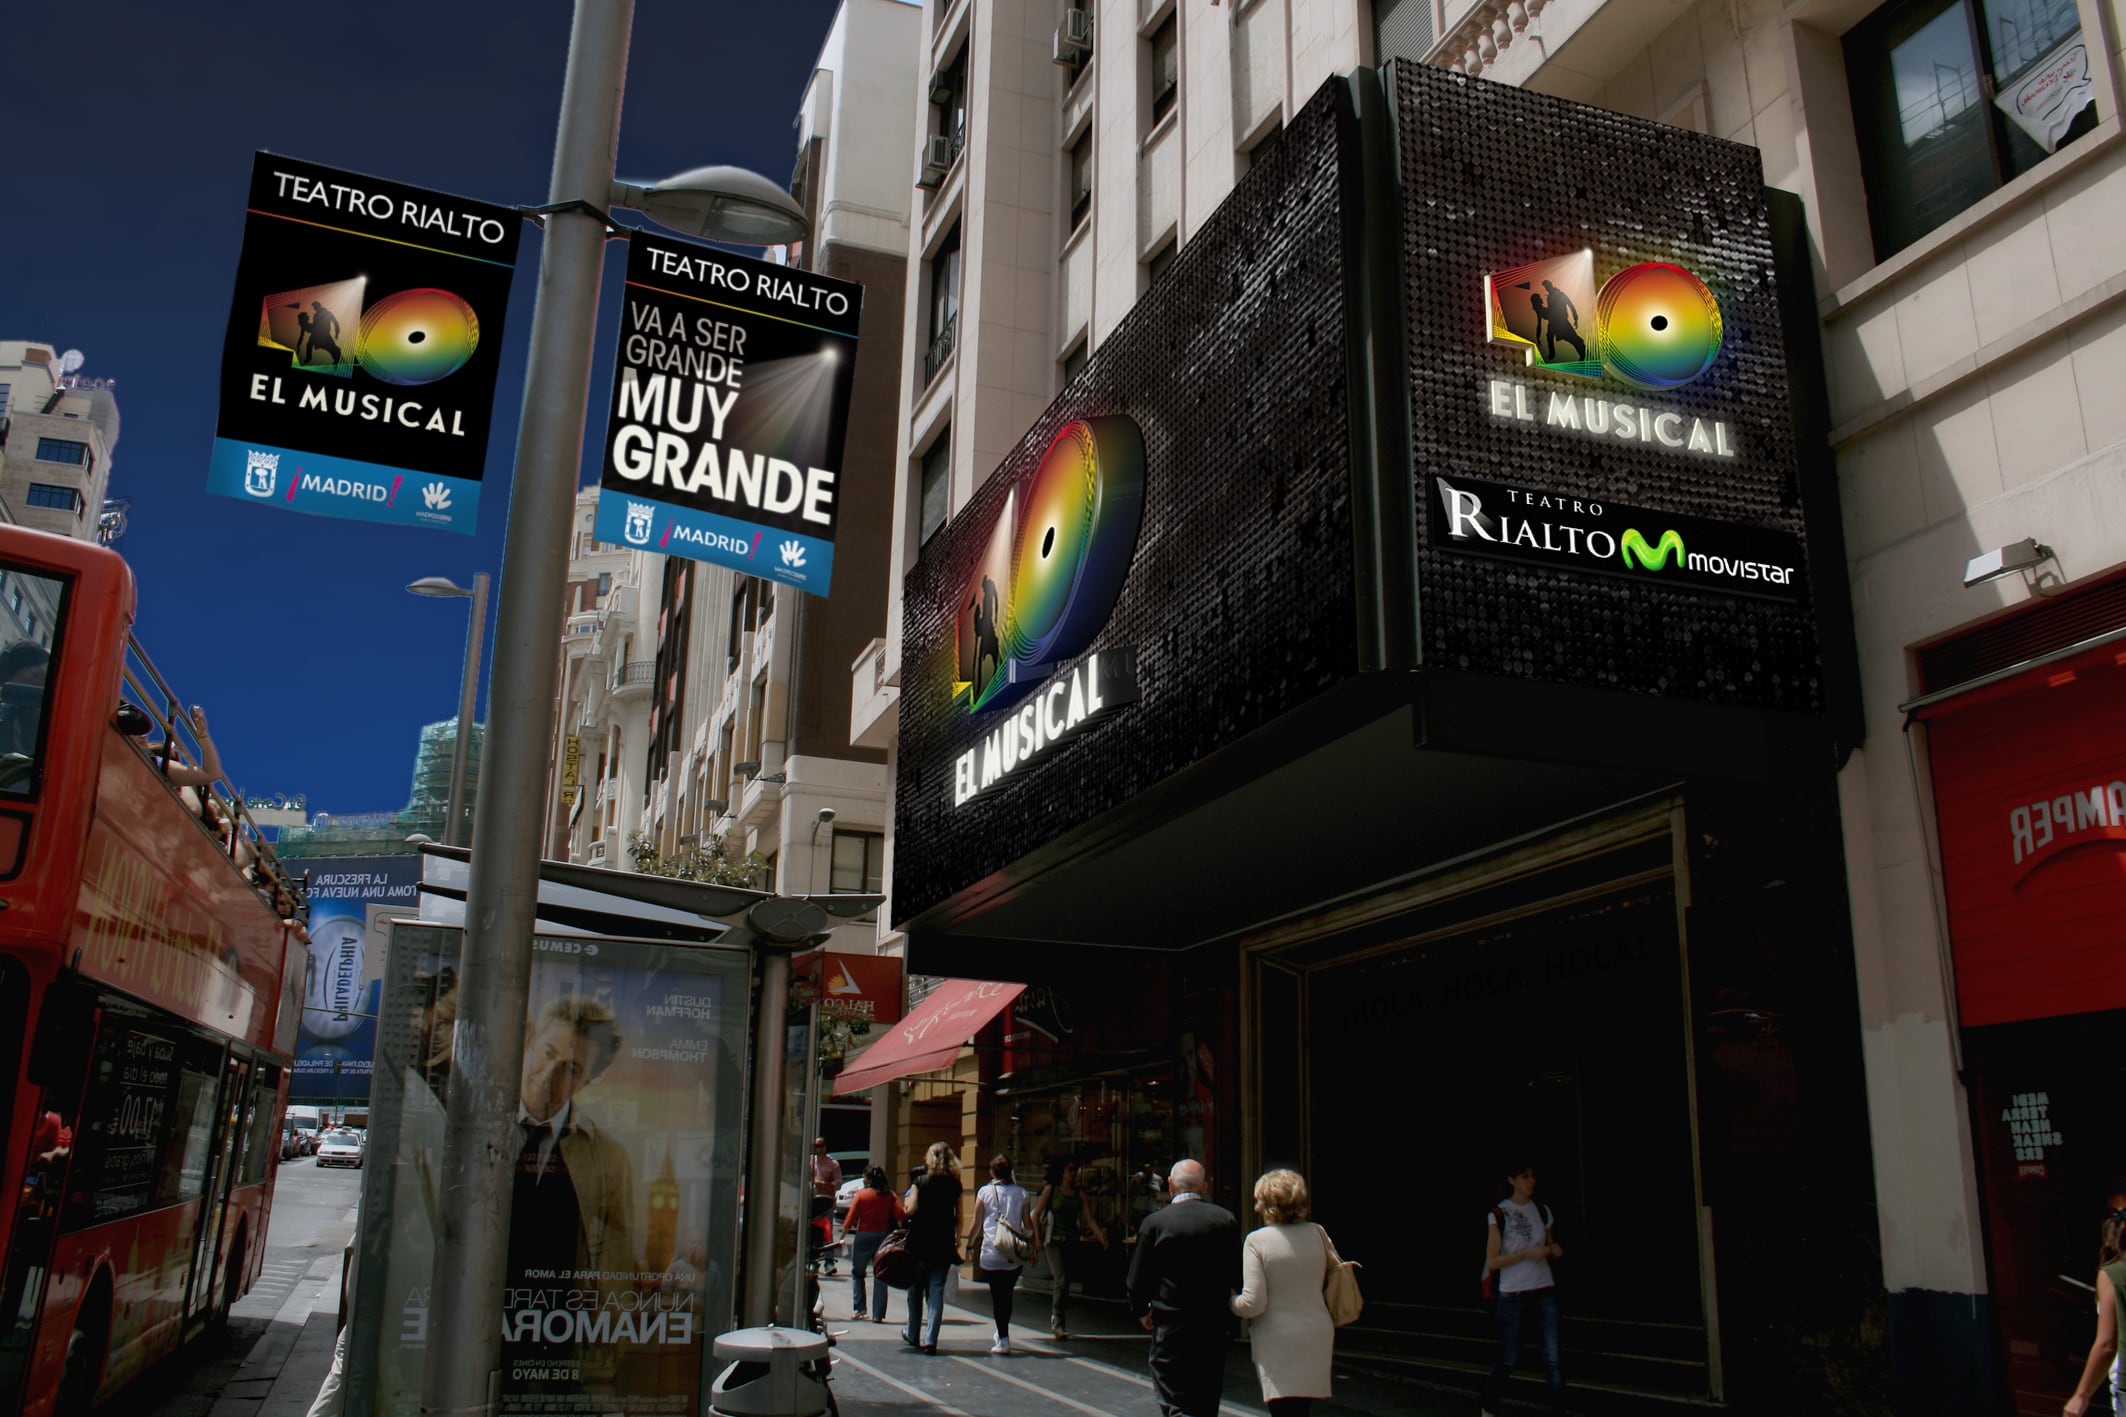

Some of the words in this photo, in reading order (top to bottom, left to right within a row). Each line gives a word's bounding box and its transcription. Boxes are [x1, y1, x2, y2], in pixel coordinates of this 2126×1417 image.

[273, 171, 394, 219] TEATRO
[401, 200, 504, 243] RIALTO
[646, 247, 750, 291] TEATRO
[756, 274, 849, 316] RIALTO
[626, 334, 744, 388] GRANDE
[631, 301, 663, 336] VA
[668, 312, 687, 342] A
[695, 317, 747, 355] SER
[250, 373, 285, 405] EL
[298, 383, 465, 437] MUSICAL
[617, 366, 740, 440] MUY
[1490, 380, 1534, 421] EL
[1546, 391, 1735, 457] MUSICAL
[612, 424, 835, 526] GRANDE
[1506, 489, 1603, 517] TEATRO
[1445, 486, 1616, 558] RIALTO
[1688, 550, 1795, 585] movistar
[954, 747, 977, 808] EL
[981, 653, 1105, 791] MUSICAL
